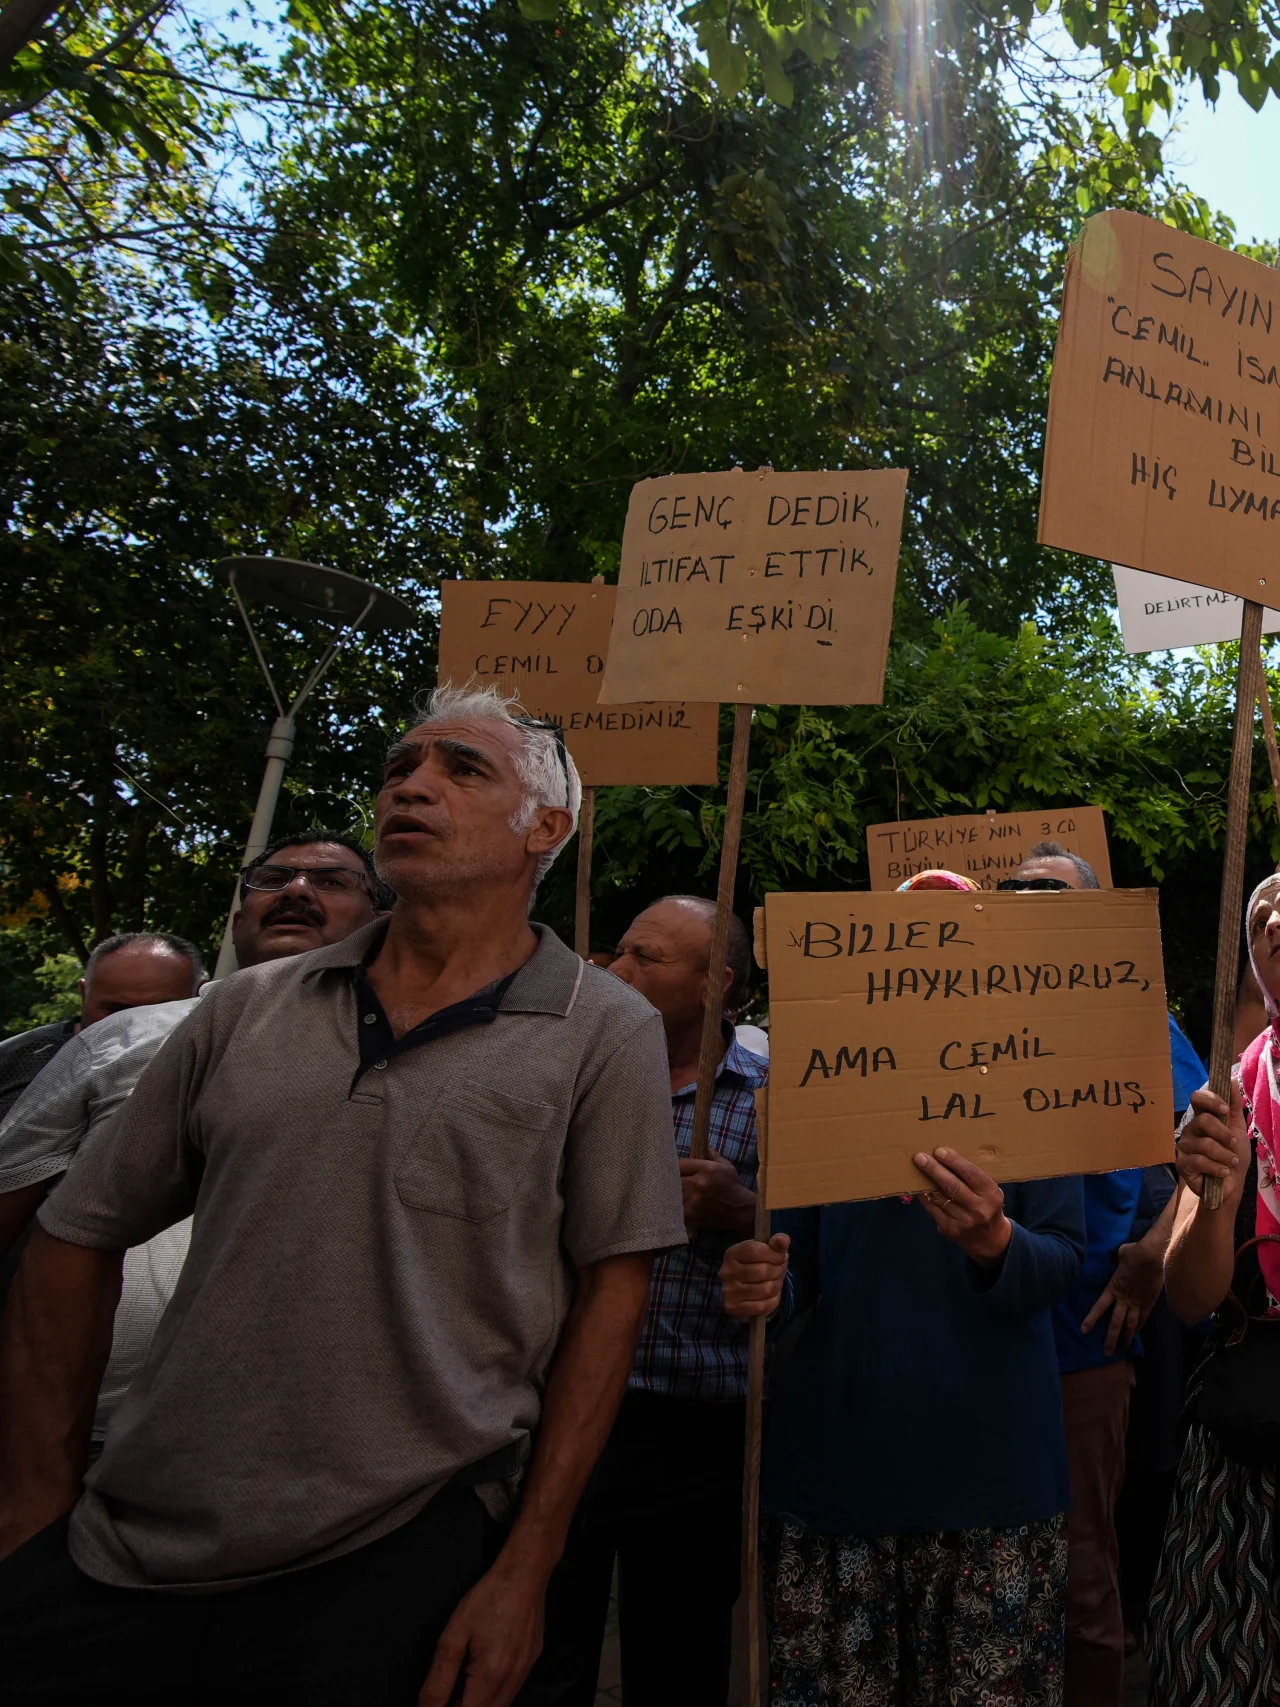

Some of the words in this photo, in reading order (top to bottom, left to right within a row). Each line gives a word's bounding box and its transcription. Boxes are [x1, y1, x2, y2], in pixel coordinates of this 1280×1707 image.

[1151, 252, 1272, 334] SAYIN
[1102, 356, 1262, 437] ANLAMINI
[1130, 452, 1177, 500] HİÇ
[648, 495, 734, 534] GENÇ
[767, 491, 879, 527] DEDİK,
[640, 551, 735, 587] İLTİFAT
[764, 540, 873, 578] ETTİK,
[480, 599, 576, 636] EYYY
[633, 607, 683, 636] ODA
[476, 648, 558, 674] CEMİL
[803, 913, 975, 959] BİZLER
[866, 960, 1150, 1005] HAYKIRIYORUZ,
[800, 1046, 897, 1087] AMA
[938, 1026, 1056, 1071] CEMİL
[917, 1093, 996, 1121] LAL
[1022, 1079, 1156, 1114] OLMUŞ.
